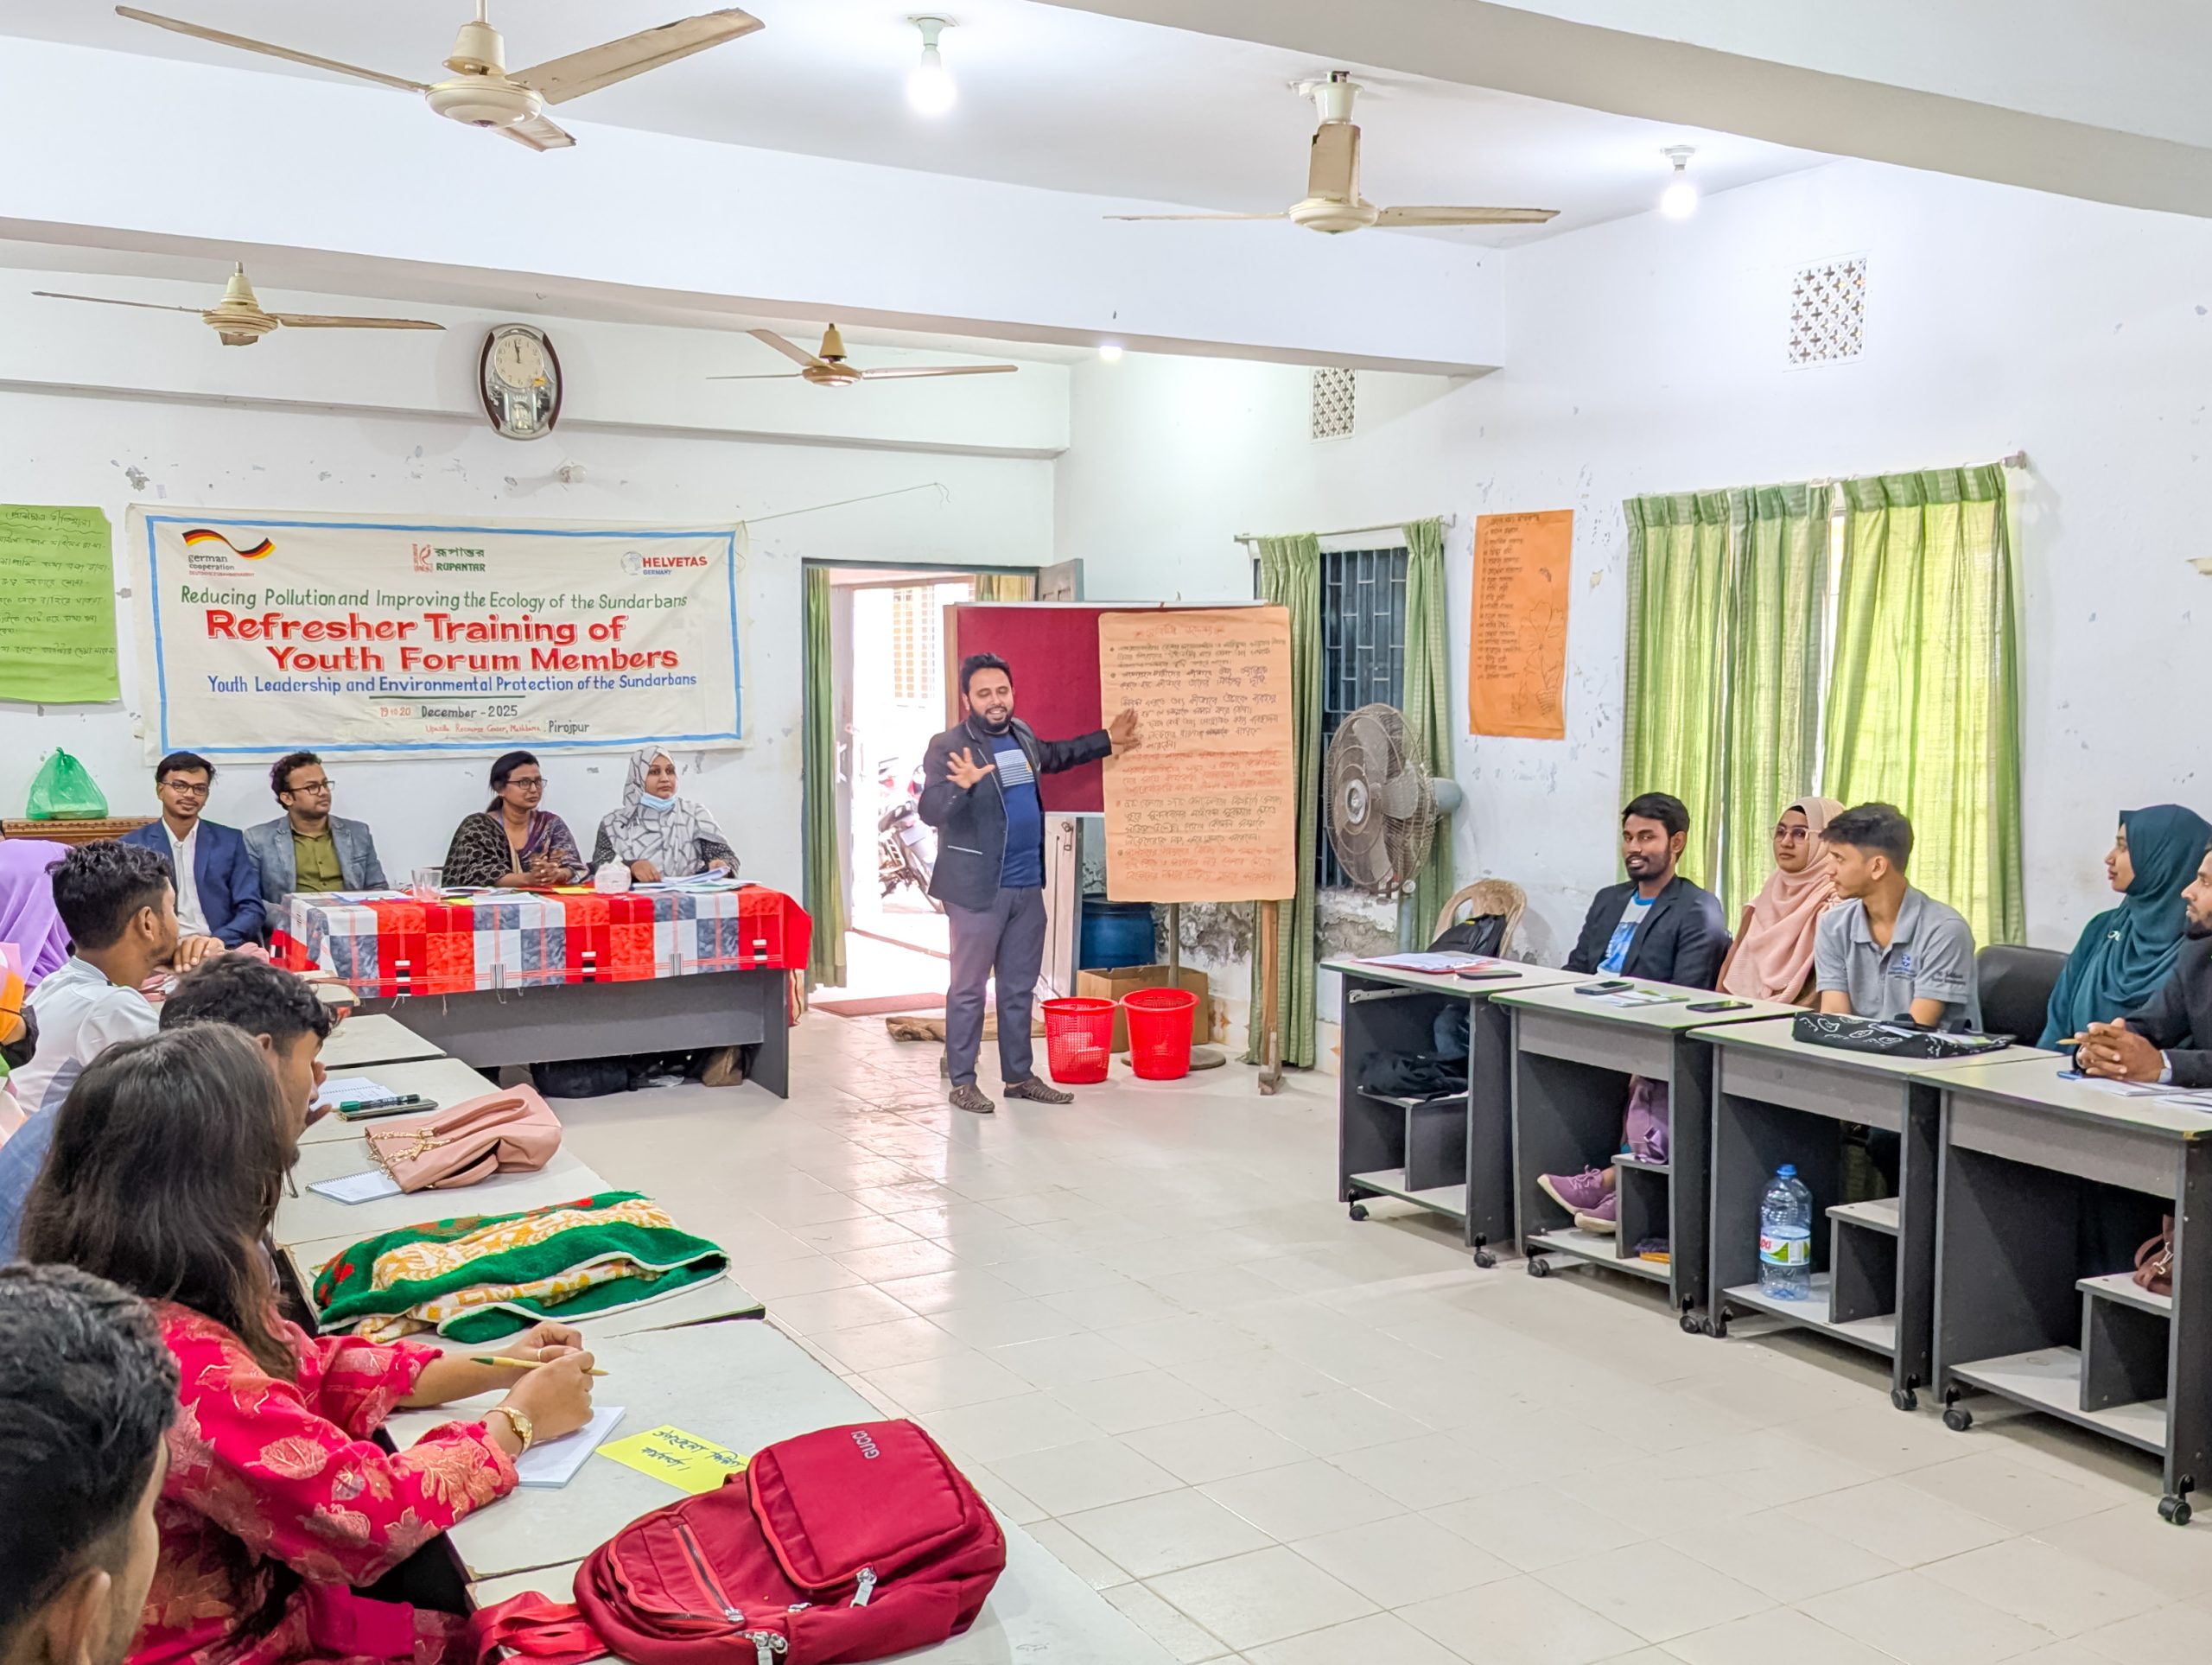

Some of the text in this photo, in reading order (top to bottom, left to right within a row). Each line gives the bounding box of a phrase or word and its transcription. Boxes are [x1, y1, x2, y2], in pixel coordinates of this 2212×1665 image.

[188, 554, 228, 563] german
[435, 562, 486, 572] RUPANTAR
[642, 556, 708, 568] HELVETAS
[181, 585, 688, 613] Reducing Pollution and Improving the Ecology of the Sundarbans
[206, 609, 630, 646] Refresher Training of
[266, 645, 680, 672] Youth Forum Members
[208, 672, 697, 696] Youth Leadership and Environmental Protection of the Sundarbans
[399, 707, 411, 716] 20
[421, 705, 477, 719] December
[488, 704, 518, 718] 2025
[549, 720, 590, 734] Pirojpur
[851, 1430, 880, 1459] GUCCI
